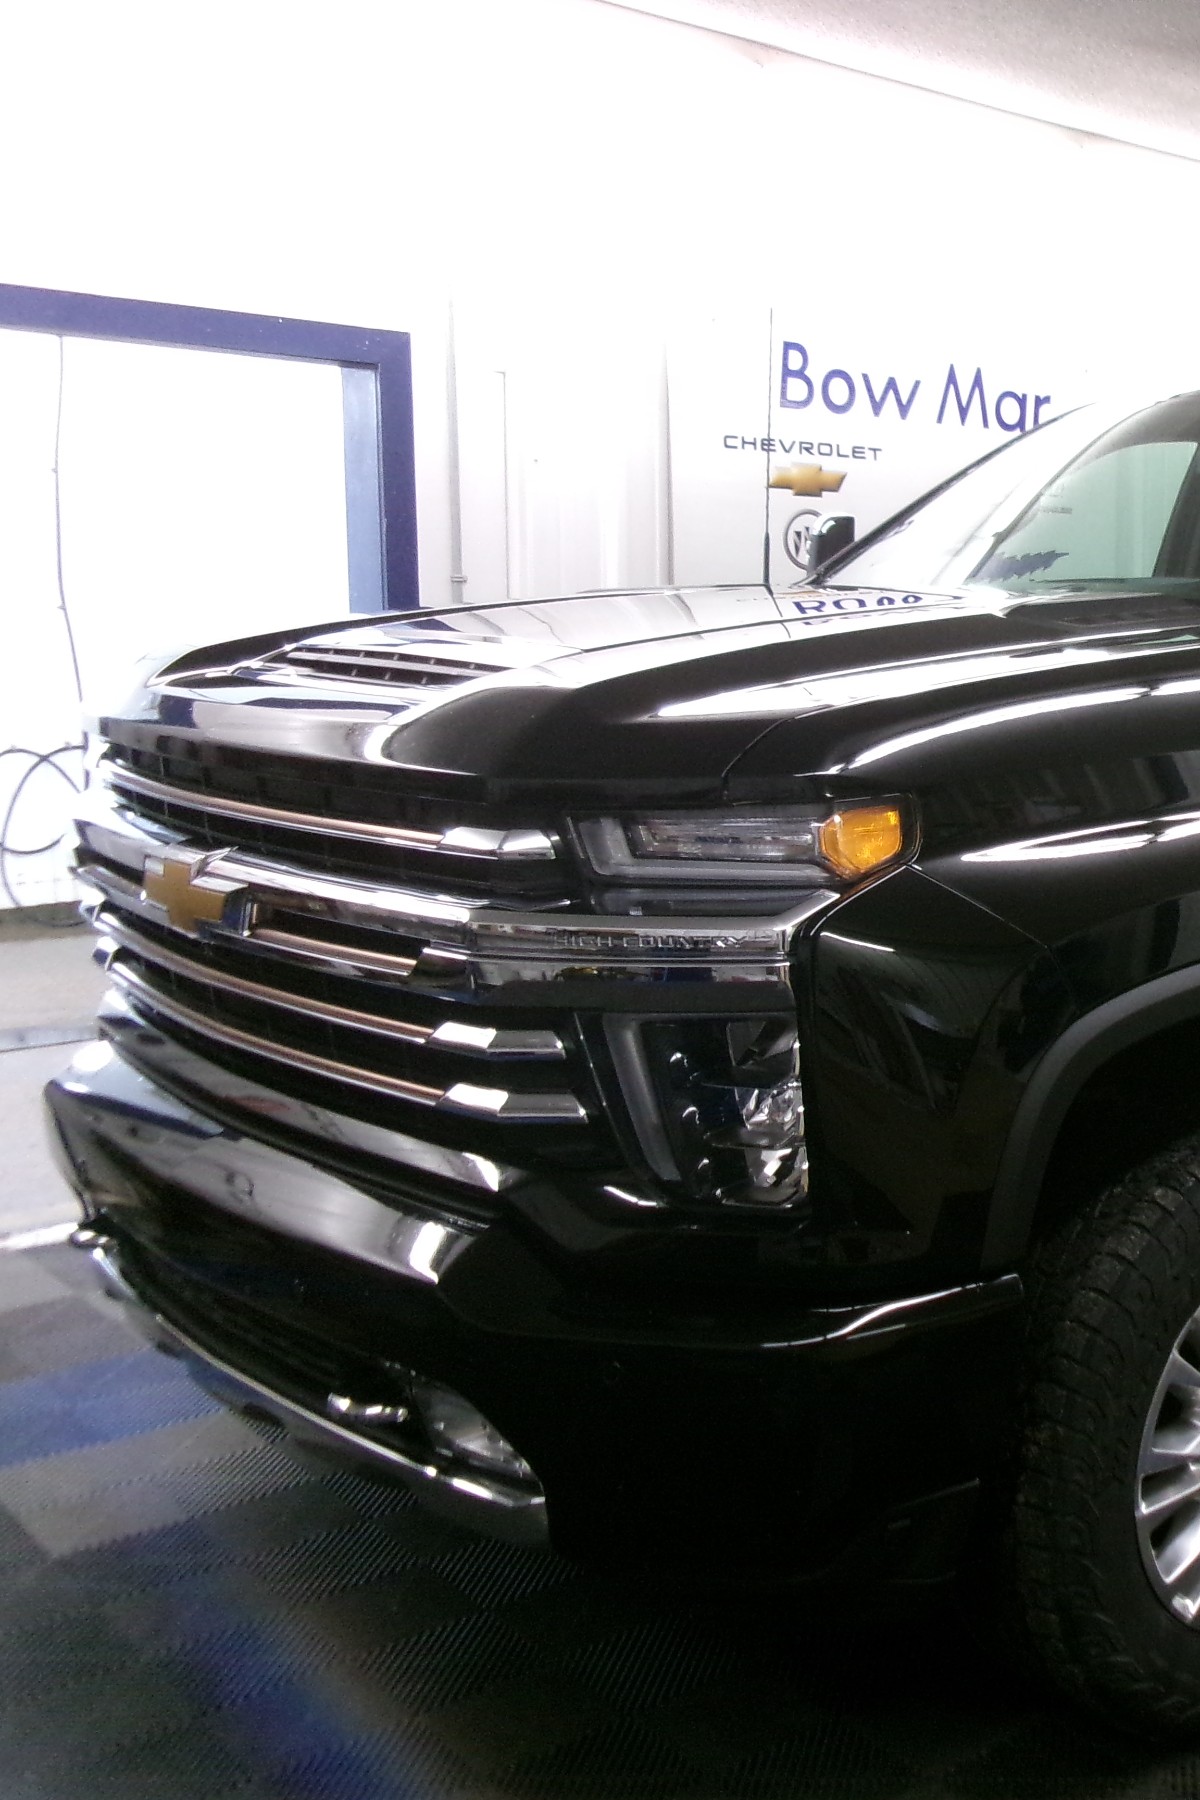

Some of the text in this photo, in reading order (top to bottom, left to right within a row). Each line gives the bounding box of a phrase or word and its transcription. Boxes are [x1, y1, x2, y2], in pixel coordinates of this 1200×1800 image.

[779, 340, 1051, 434] Bow Mar
[723, 434, 882, 461] CHEVROLET
[553, 933, 747, 949] HIGH COUNTRY
